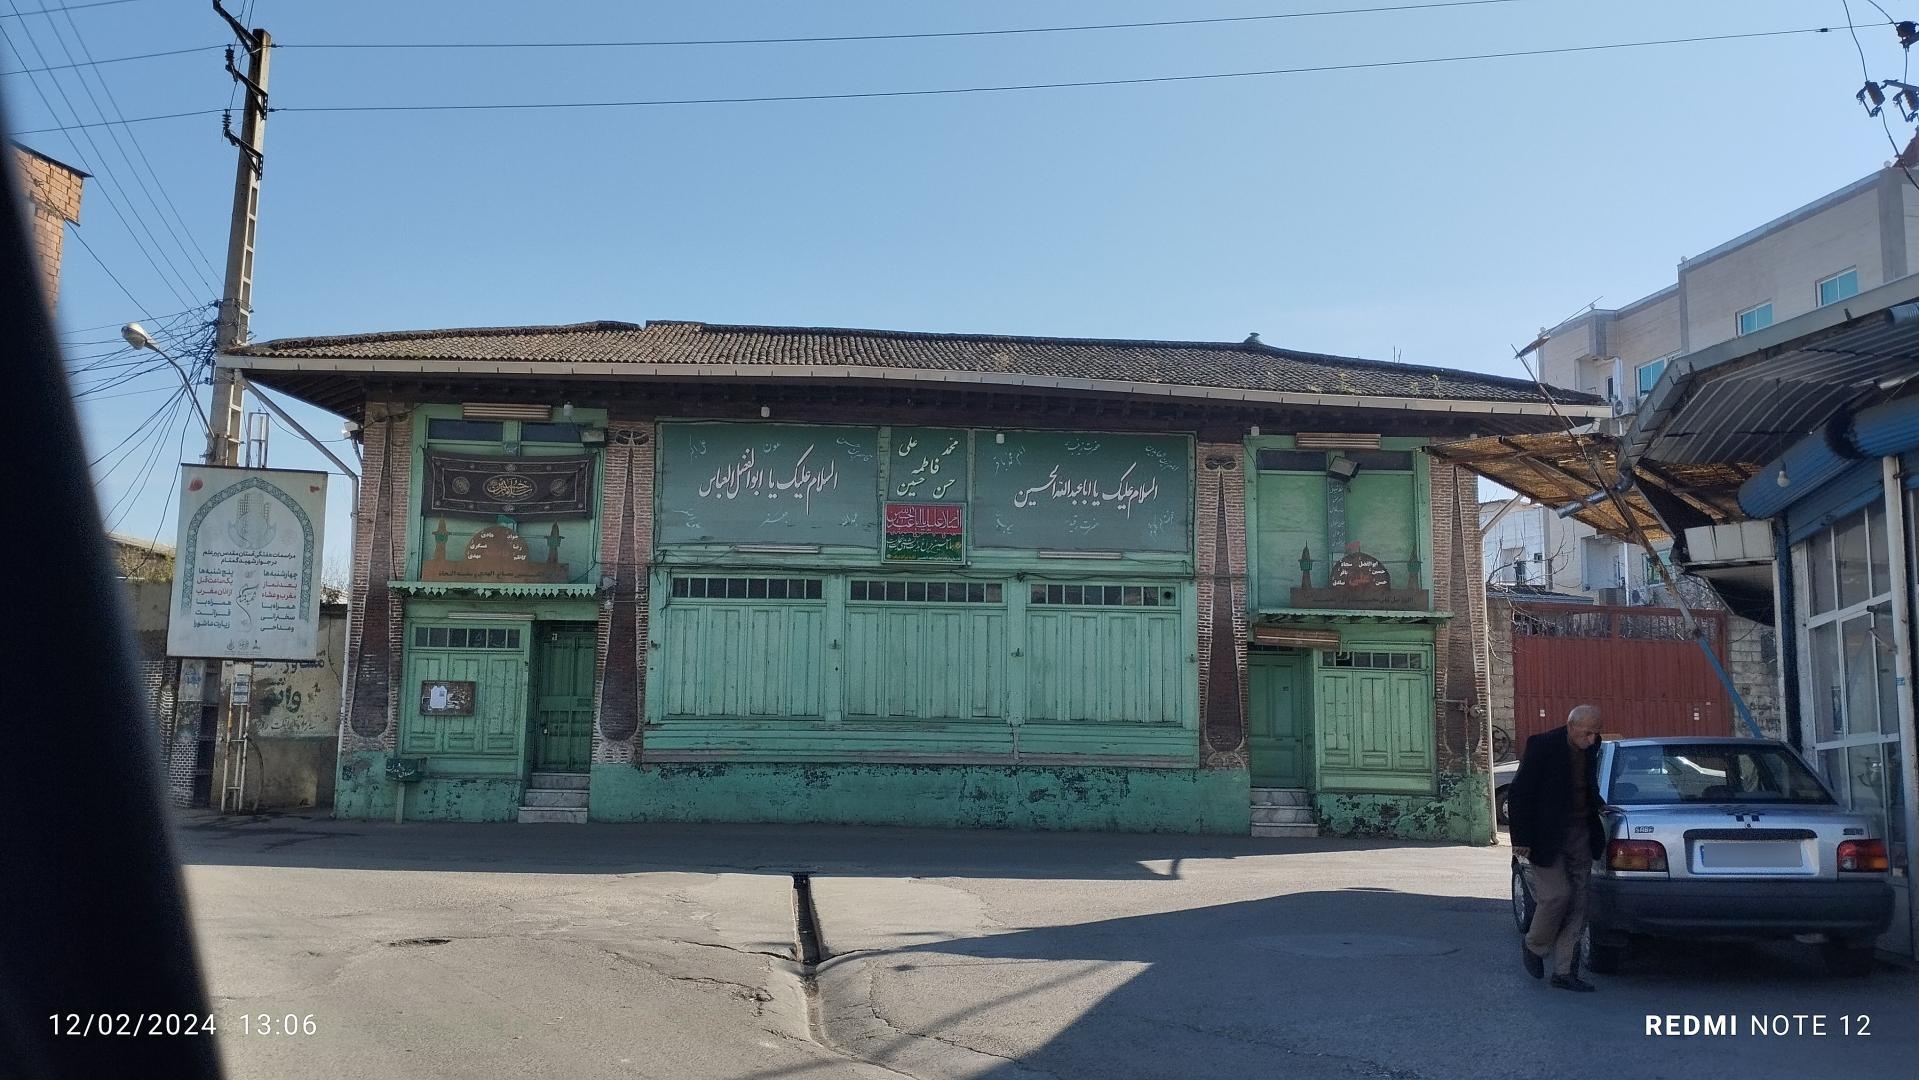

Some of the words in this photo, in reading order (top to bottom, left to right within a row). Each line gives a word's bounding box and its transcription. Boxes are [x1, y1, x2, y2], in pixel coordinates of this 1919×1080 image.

[898, 436, 918, 456] علی
[941, 437, 959, 456] محمد
[777, 443, 814, 499] علیک
[911, 456, 940, 475] فاطمه
[768, 467, 779, 499] یا
[807, 459, 838, 516] السلام
[896, 477, 926, 497] حسین
[932, 479, 956, 499] حسن
[1102, 462, 1137, 510] علیک
[1128, 477, 1159, 520] السلام
